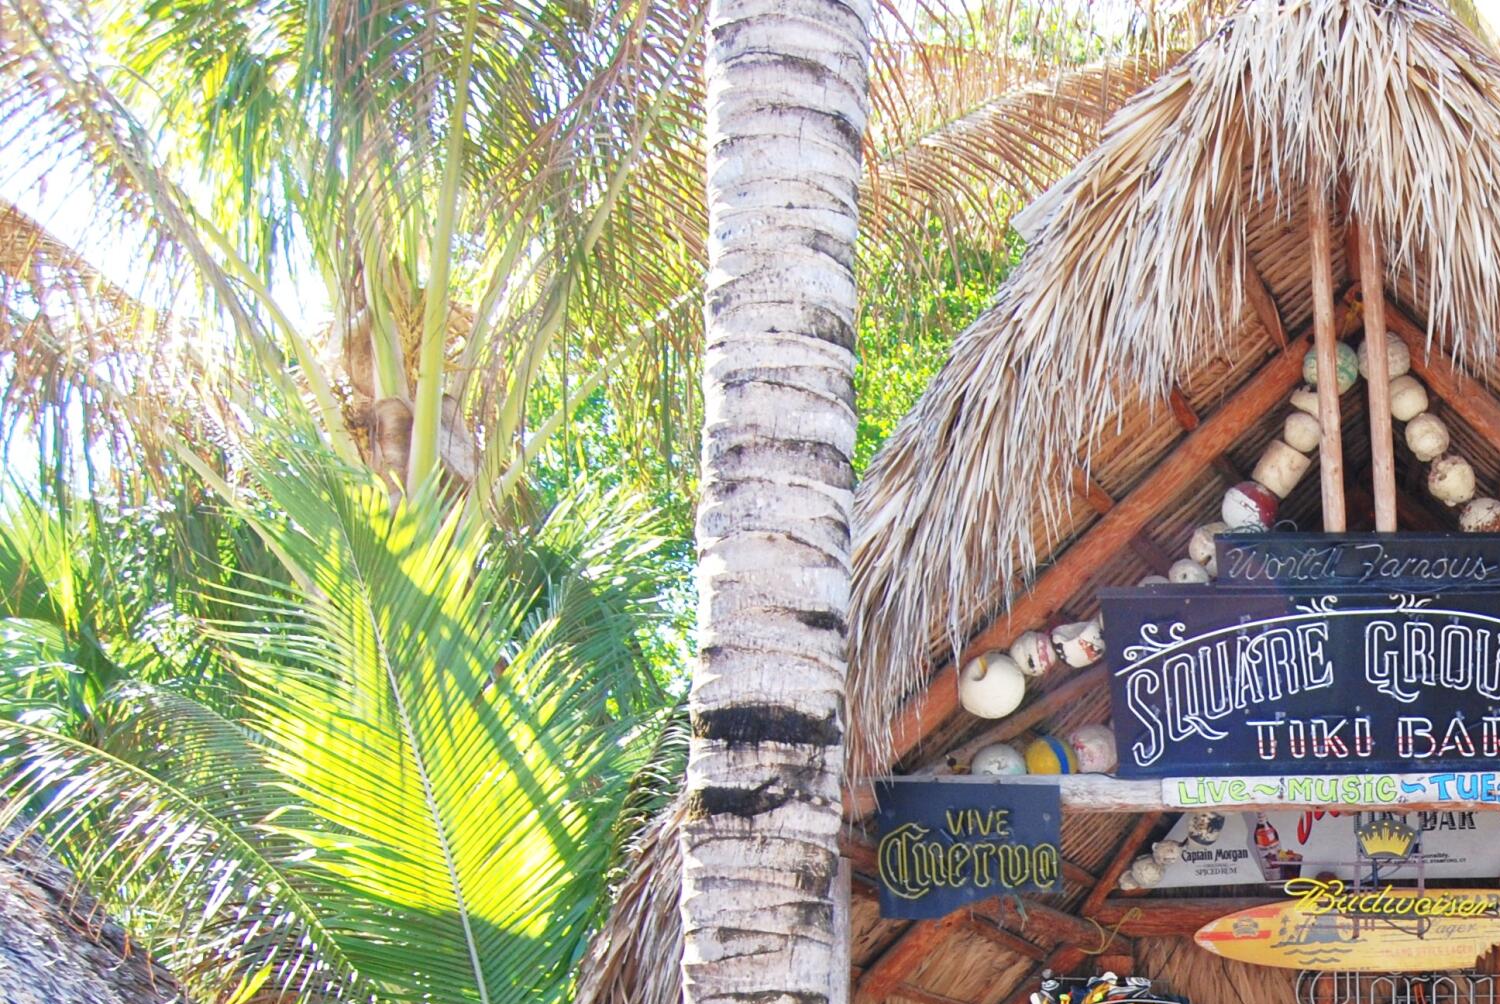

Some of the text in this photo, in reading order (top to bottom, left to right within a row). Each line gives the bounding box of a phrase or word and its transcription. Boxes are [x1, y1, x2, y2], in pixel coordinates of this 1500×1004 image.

[1226, 543, 1498, 583] World Famous
[1126, 622, 1334, 767] SQUARE
[1246, 717, 1372, 760] TIKI
[945, 809, 1011, 836] VIVE
[878, 822, 1057, 900] Cuervo
[1181, 848, 1249, 864] Captain Morgan
[1284, 877, 1494, 917] Budweiser
